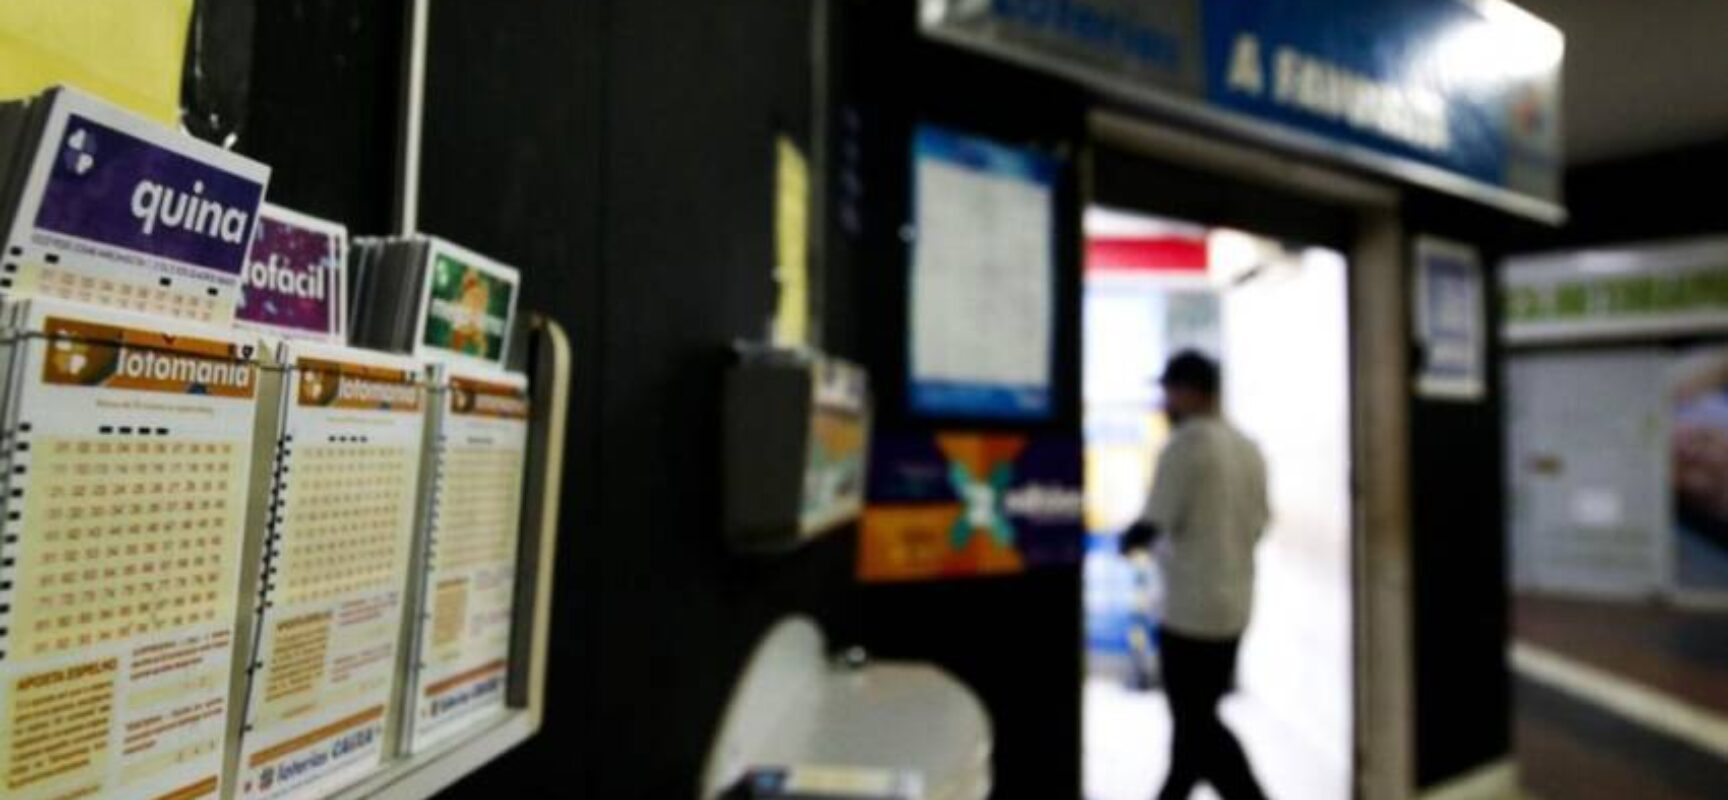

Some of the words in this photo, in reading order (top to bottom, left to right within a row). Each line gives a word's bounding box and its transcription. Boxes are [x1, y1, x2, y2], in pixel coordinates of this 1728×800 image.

[131, 179, 248, 244] quina
[246, 253, 325, 300] ofácil
[116, 347, 250, 388] lotomania
